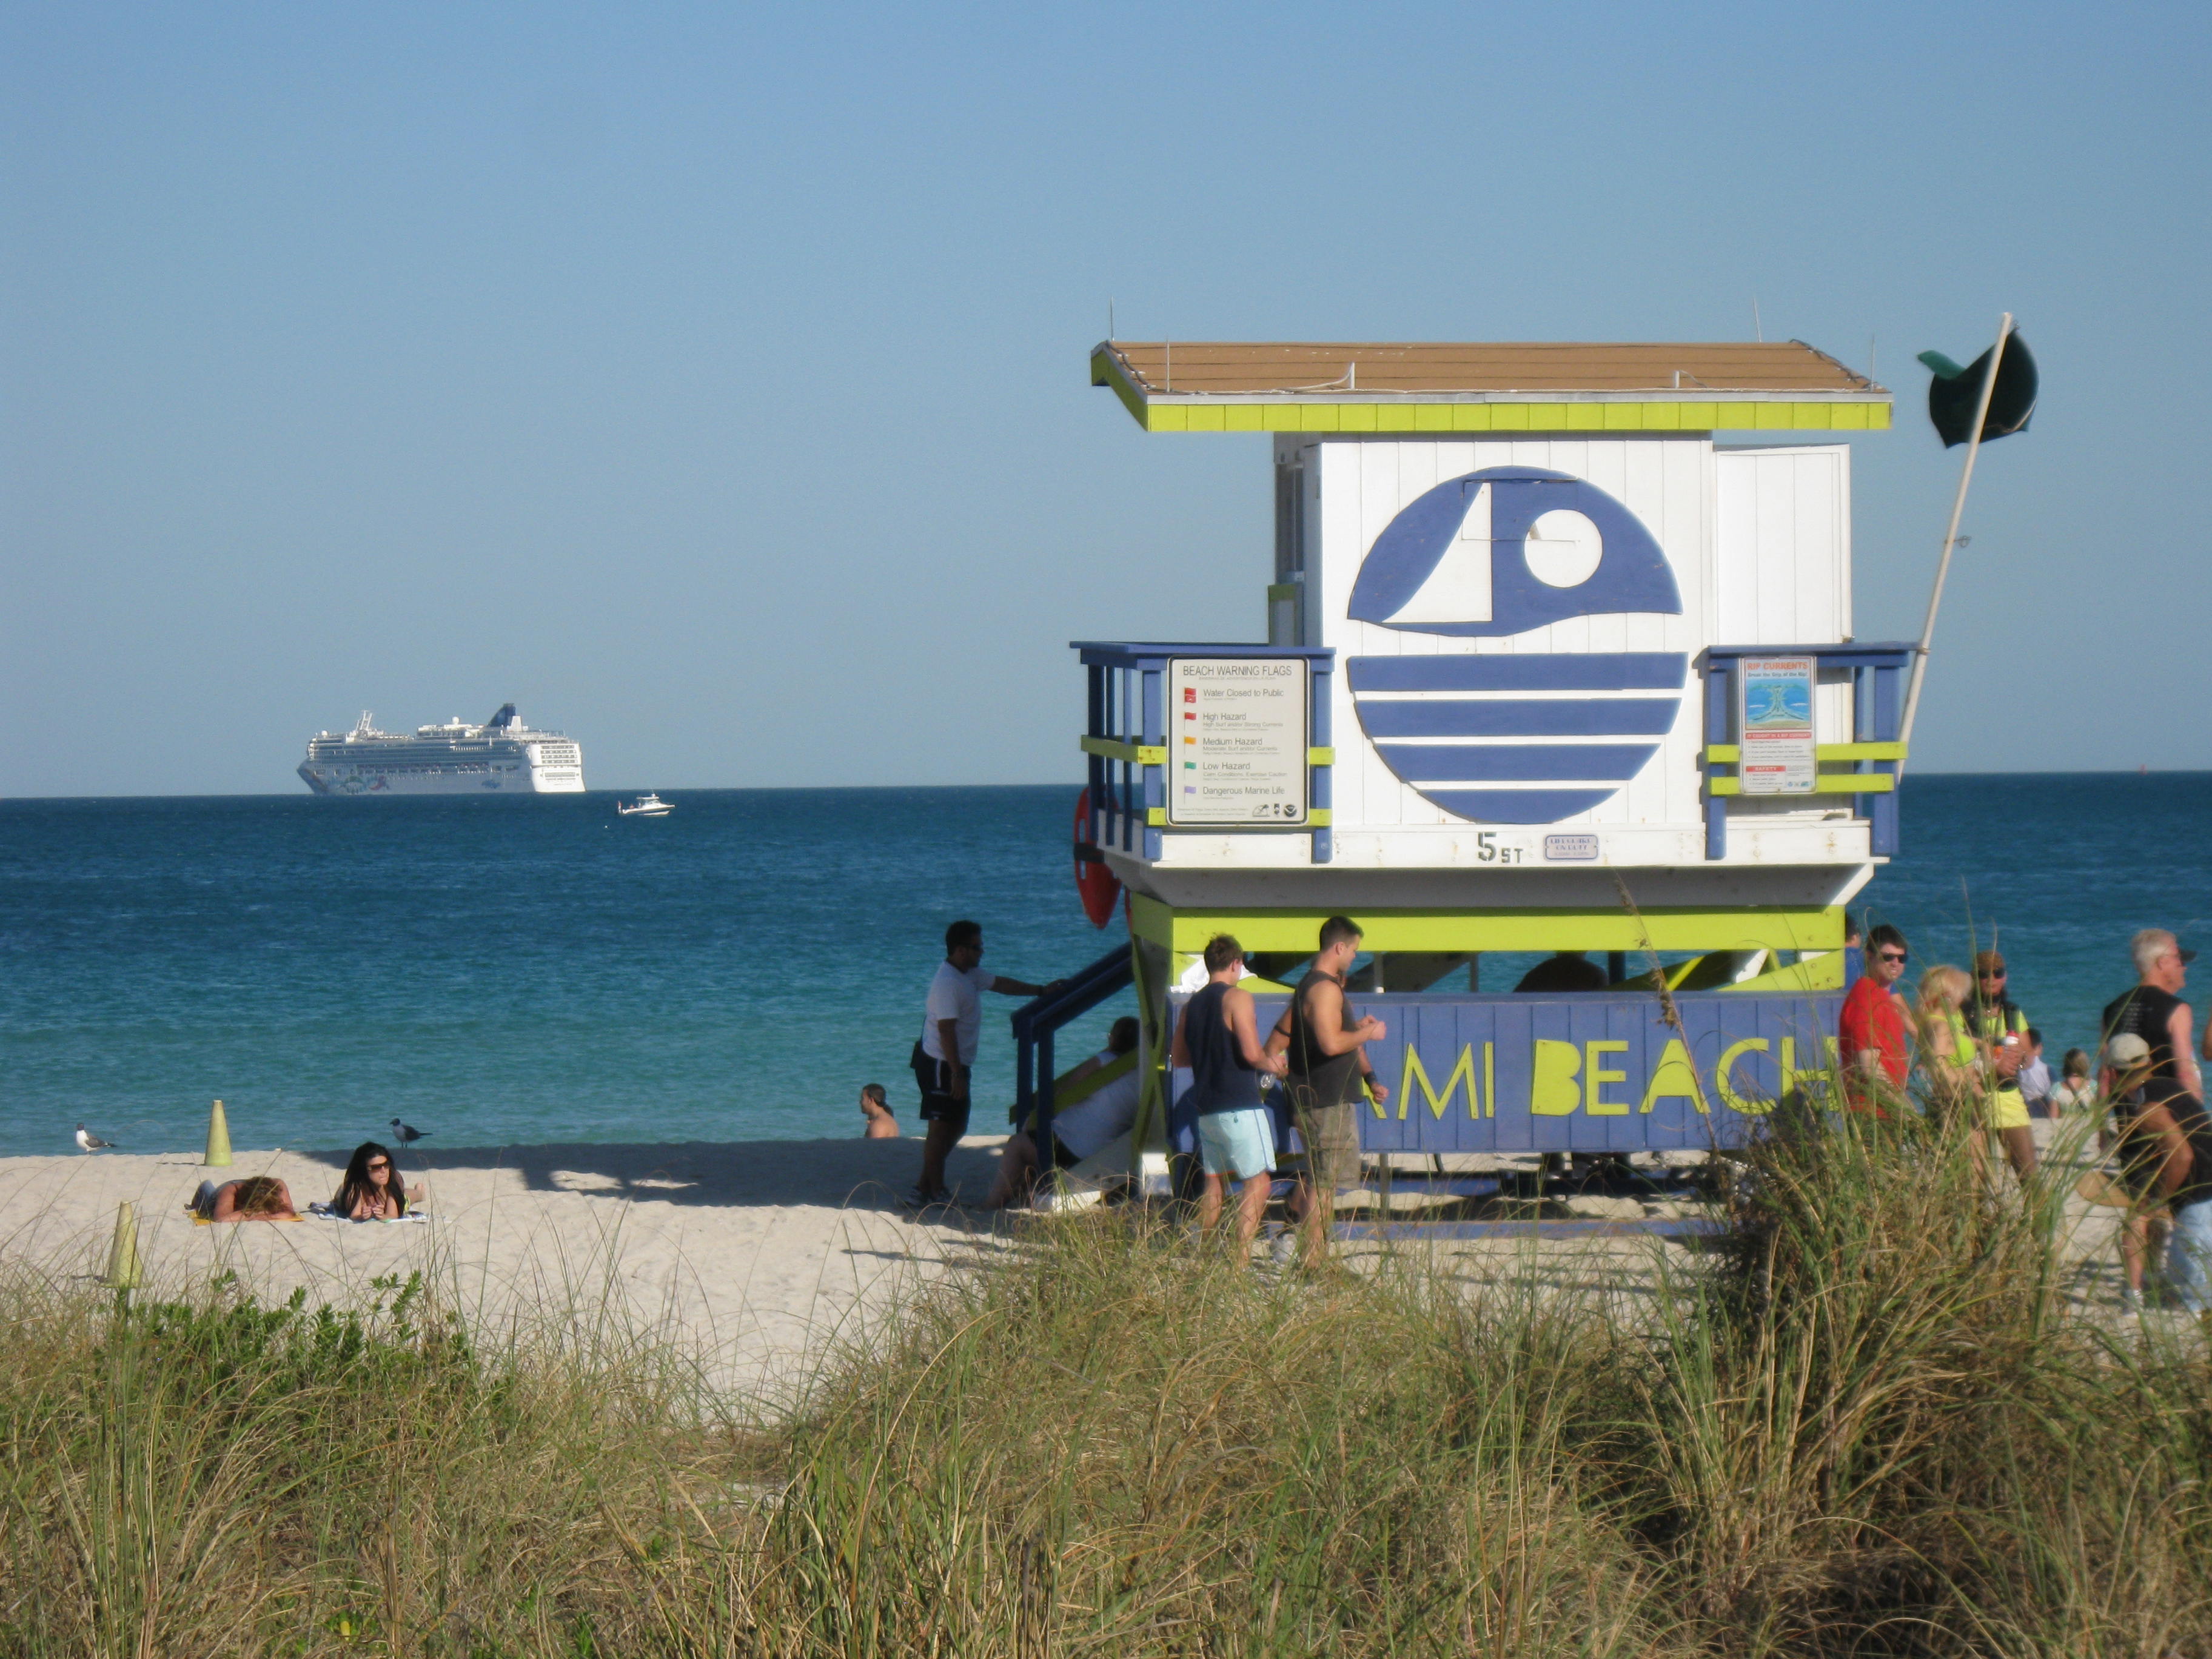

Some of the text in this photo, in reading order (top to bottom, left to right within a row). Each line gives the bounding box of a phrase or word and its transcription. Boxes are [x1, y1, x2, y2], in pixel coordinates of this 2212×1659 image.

[1183, 665, 1292, 676] BEACH WARNING FLAGS
[1763, 662, 1808, 670] CURRENTS
[1227, 688, 1252, 697] Closed
[1263, 688, 1284, 697] Public
[1203, 712, 1219, 722] High
[1203, 786, 1242, 796] Dangerous
[1478, 831, 1524, 863] 5 ST
[1531, 1036, 1839, 1116] BEACH
